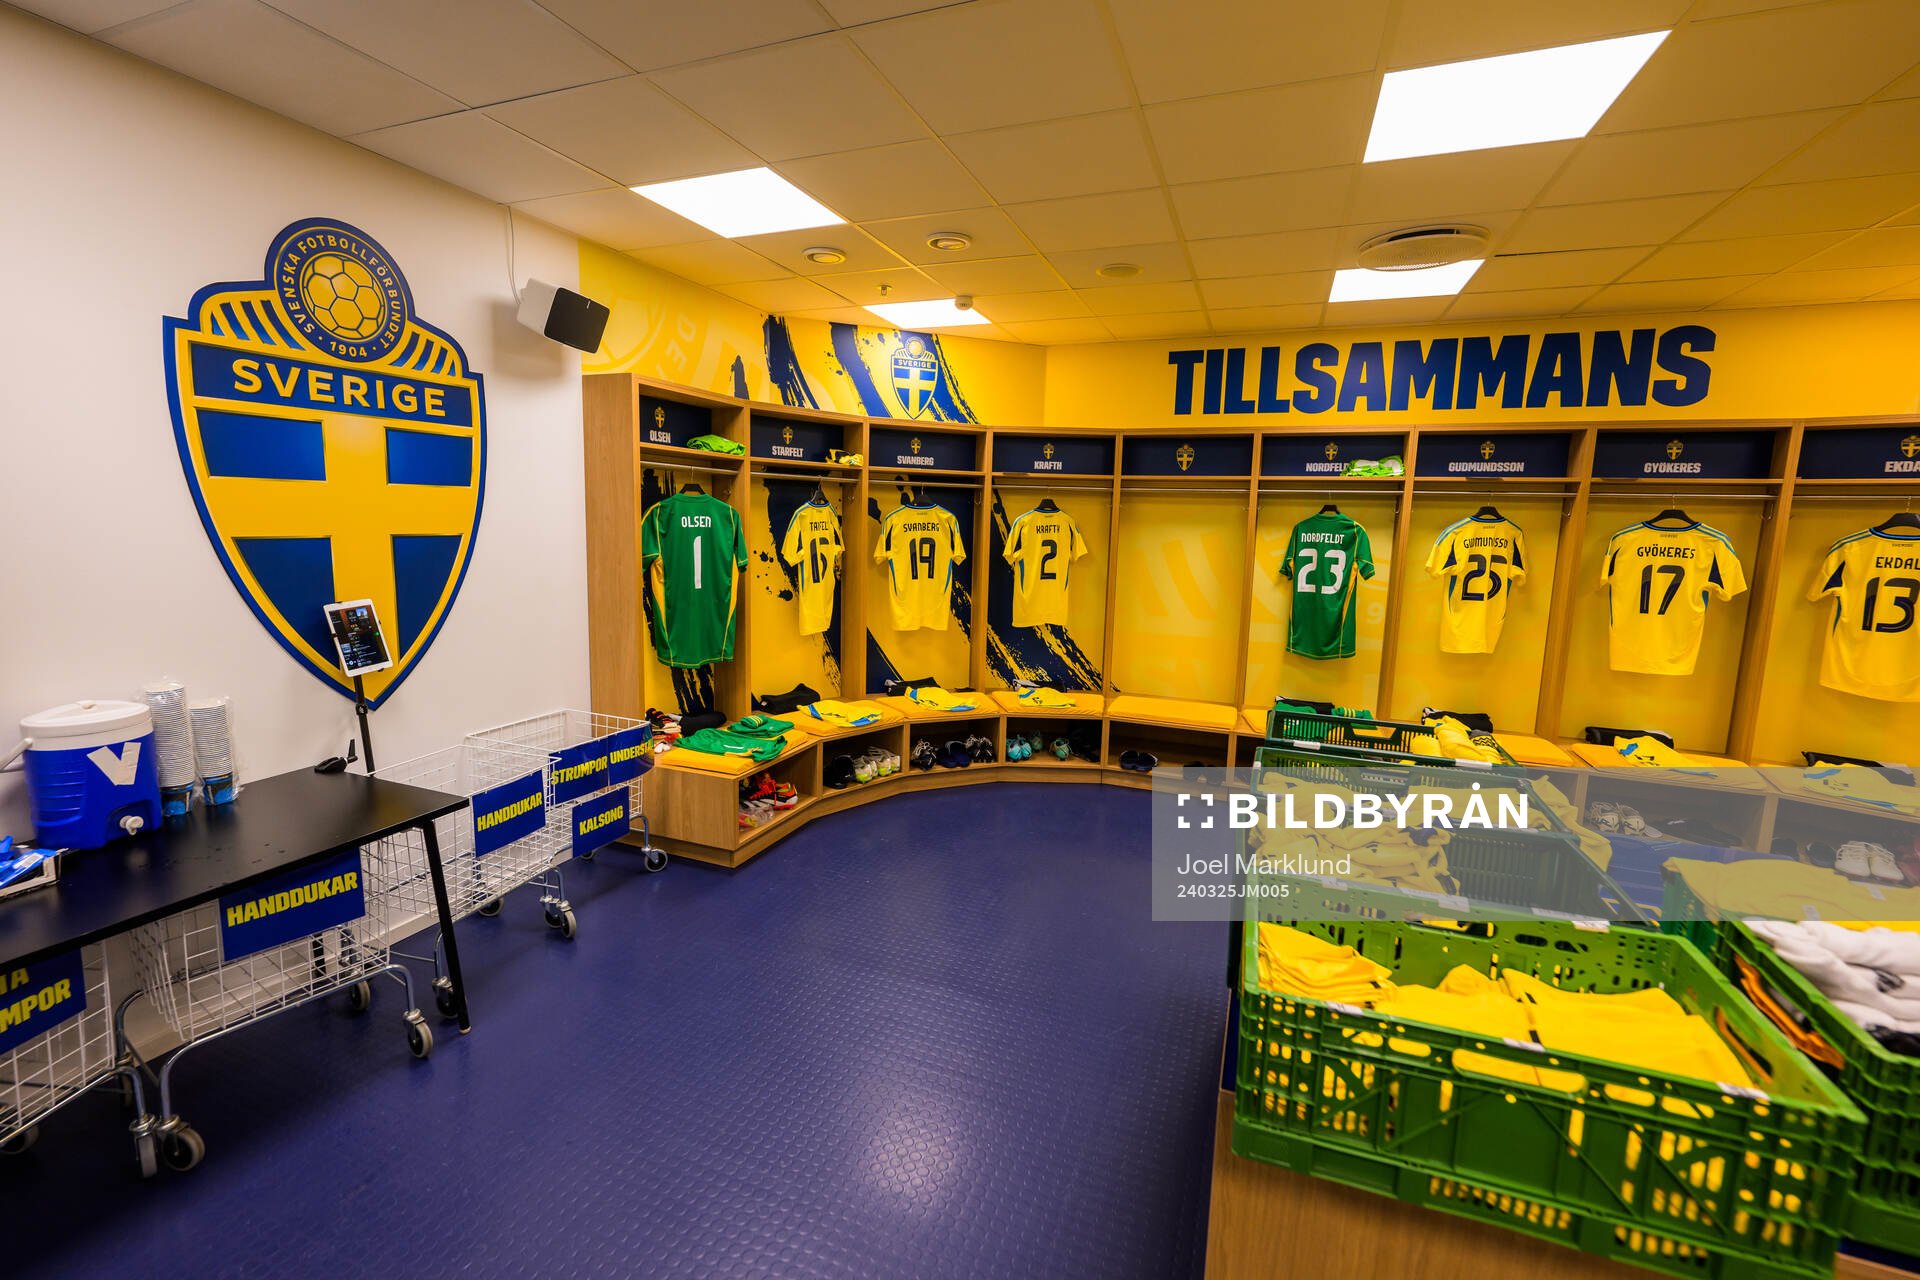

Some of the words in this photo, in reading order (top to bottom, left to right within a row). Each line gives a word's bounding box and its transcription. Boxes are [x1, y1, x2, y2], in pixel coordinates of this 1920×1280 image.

[282, 253, 315, 333] SVENSKA
[330, 341, 367, 357] 1904
[898, 360, 932, 369] SVERIGE
[1168, 325, 1717, 415] TILLSAMMANS
[232, 359, 446, 417] SVERIGE
[650, 430, 671, 444] OLSEN
[772, 445, 804, 458] STARFELT
[897, 455, 935, 467] SVANBERG
[1034, 461, 1063, 470] KRAFTH
[1448, 462, 1525, 473] GUDMUNDSSON
[1644, 461, 1702, 473] GYÖKERES
[681, 515, 712, 528] OLSEN
[903, 522, 940, 532] SVANBERG
[1301, 532, 1345, 544] NORDFELDT
[1637, 544, 1696, 559] GYÖKERES
[693, 535, 702, 589] 1
[909, 537, 936, 580] 19
[1040, 539, 1058, 580] 2
[1297, 548, 1347, 595] 23
[1461, 553, 1508, 601] 25
[1639, 564, 1686, 615] 17
[1862, 576, 1920, 633] 13
[551, 755, 608, 786] STRUMPOR
[477, 791, 543, 832] HANDDUKAR
[579, 805, 624, 836] KALSONG
[226, 871, 359, 928] HANDDUKAR
